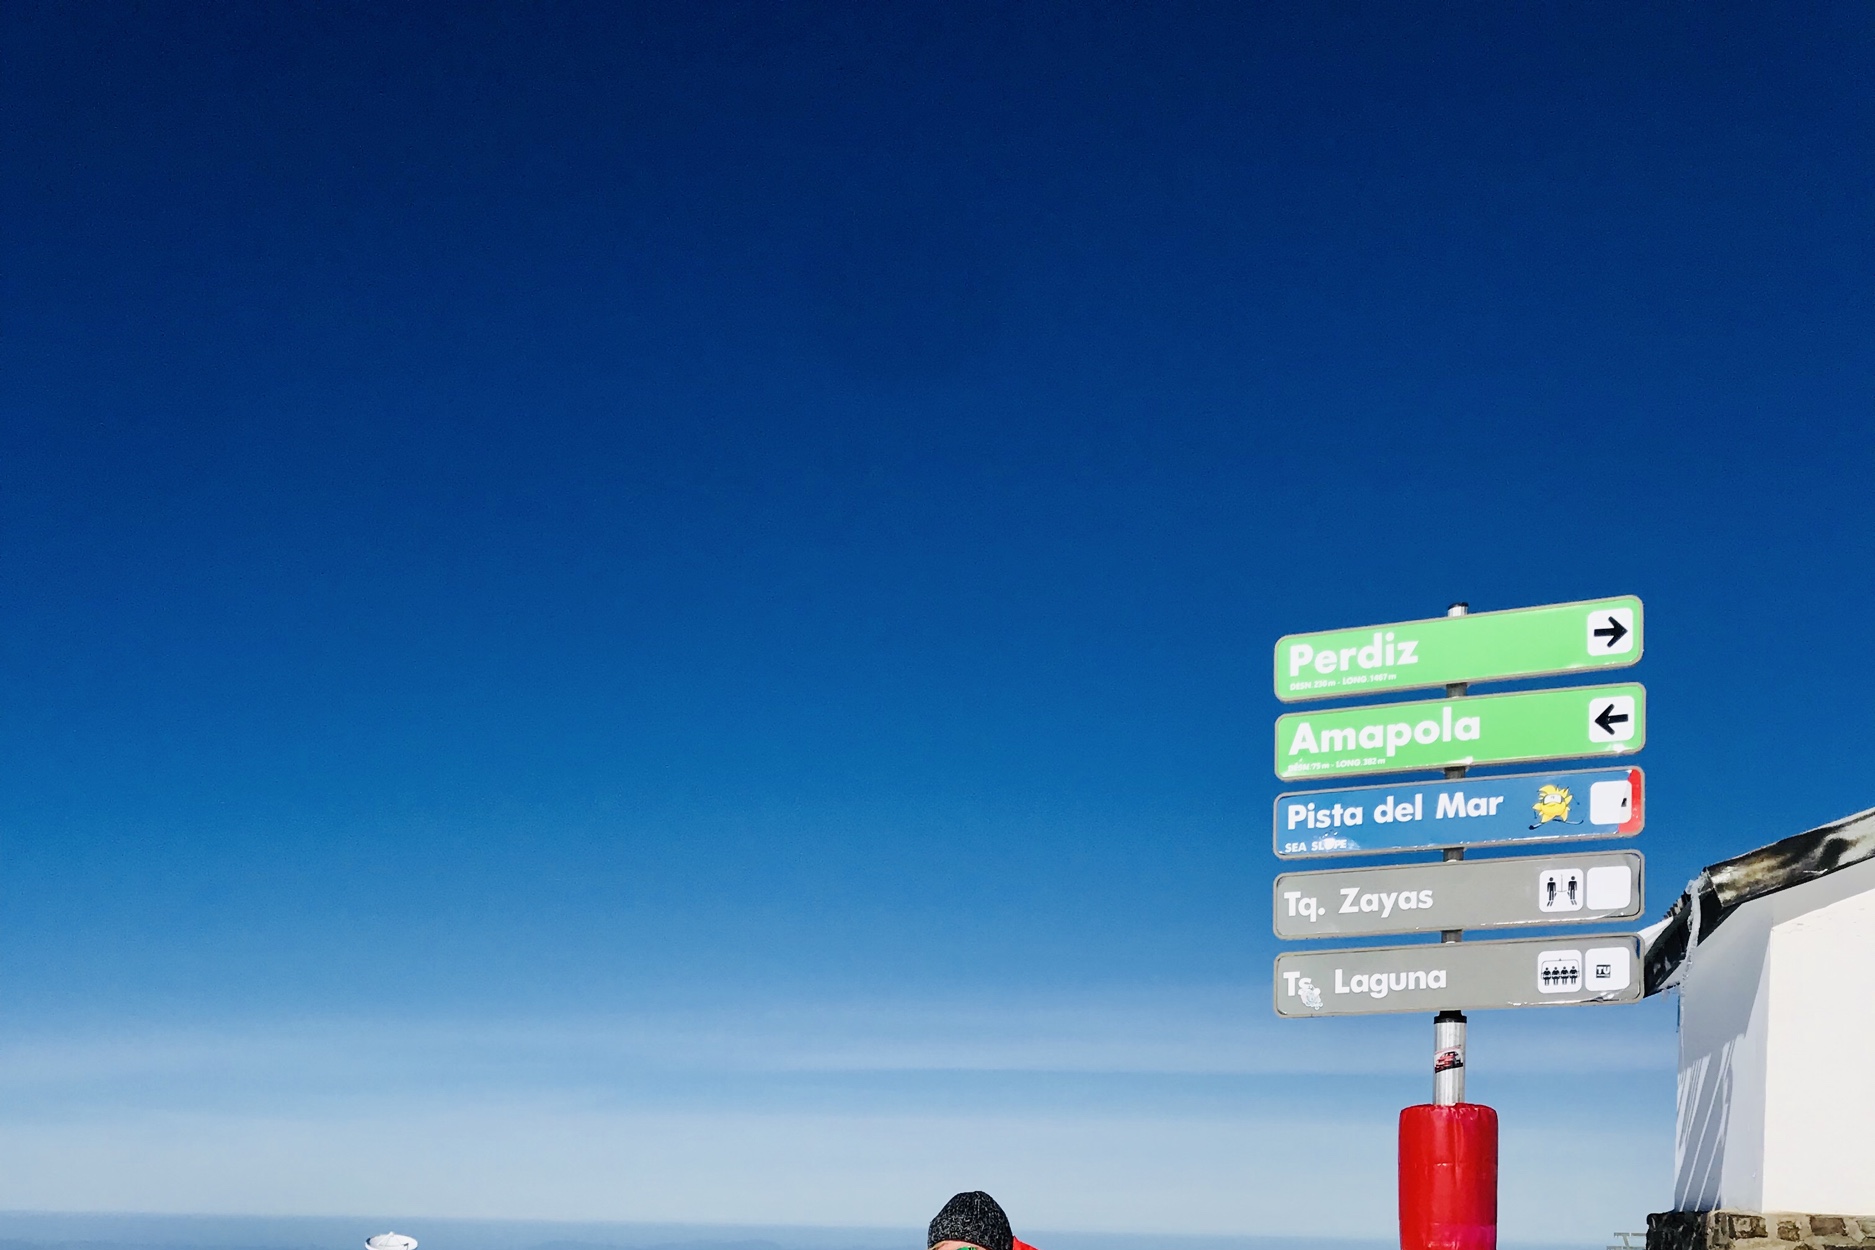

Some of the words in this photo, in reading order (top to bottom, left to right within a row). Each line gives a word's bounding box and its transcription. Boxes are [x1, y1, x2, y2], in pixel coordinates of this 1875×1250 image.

[1289, 632, 1419, 677] Perdiz
[1288, 706, 1480, 757] Amapola
[1287, 802, 1363, 830] Pista
[1373, 794, 1423, 823] del
[1435, 790, 1504, 818] Mar
[1284, 841, 1307, 853] SEA
[1283, 891, 1326, 923] Tq.
[1338, 887, 1434, 918] Zayas
[1334, 968, 1447, 998] Laguna
